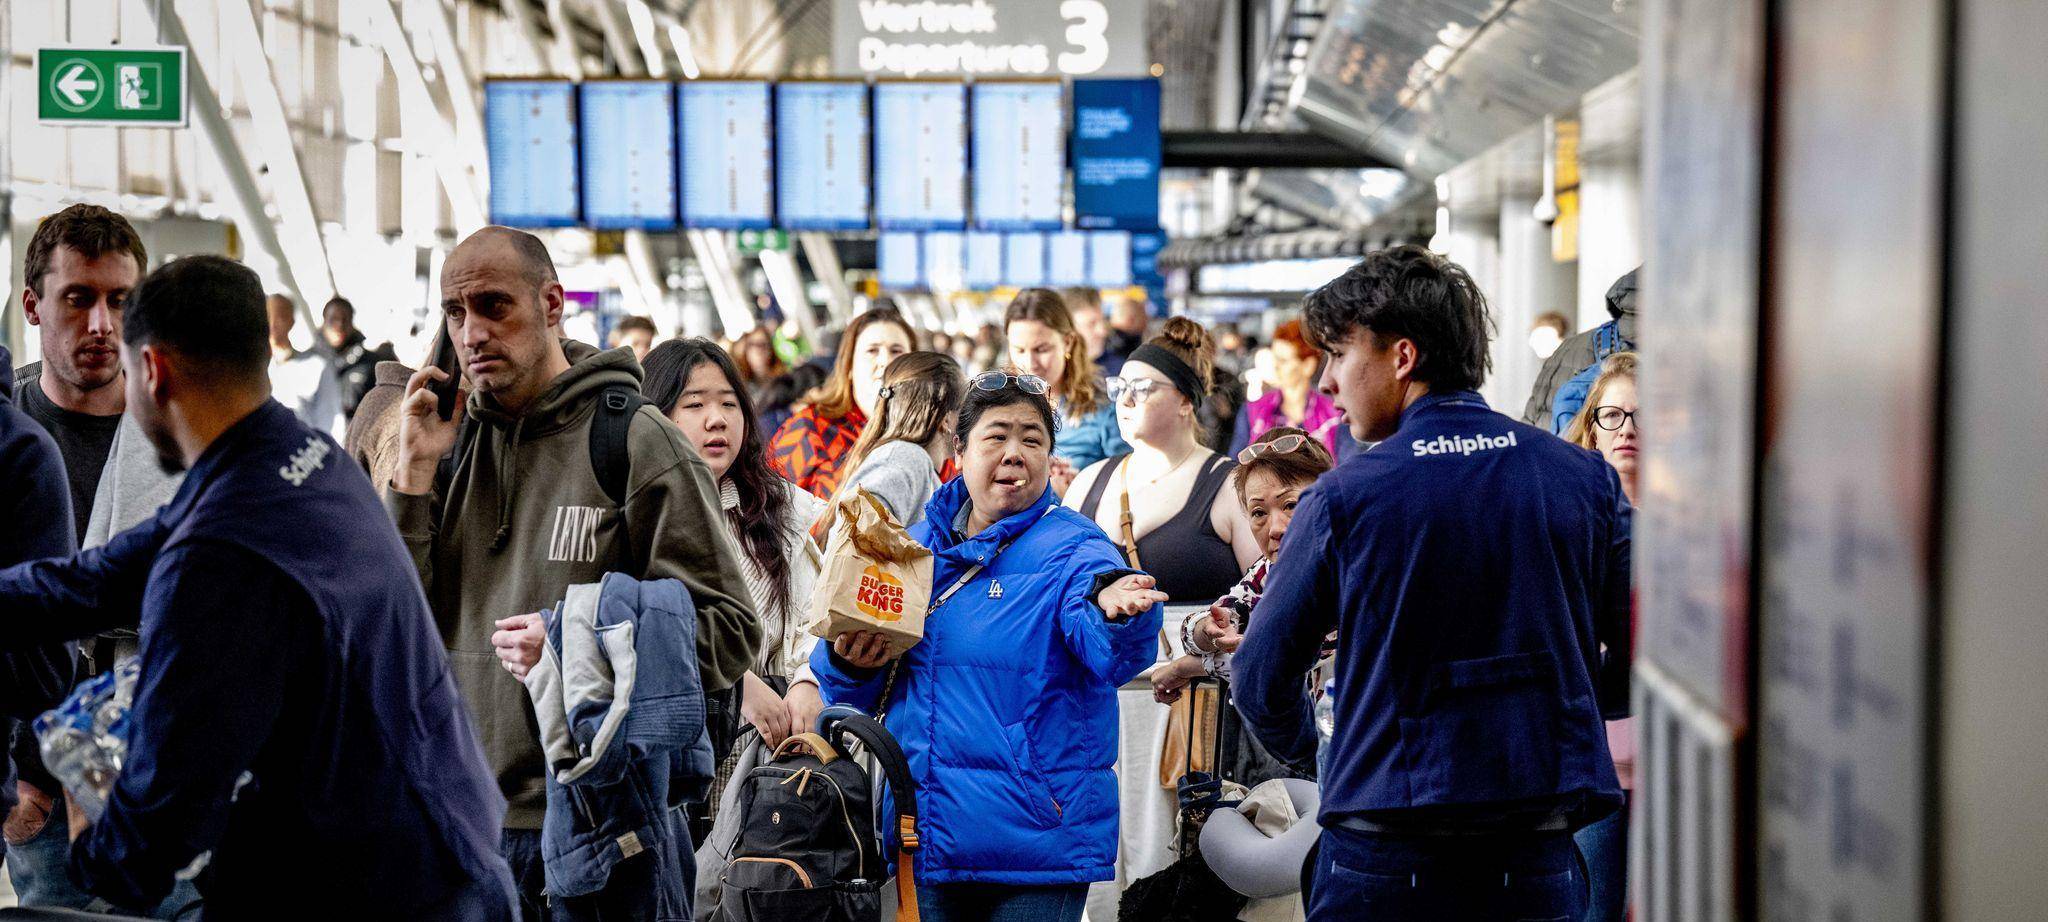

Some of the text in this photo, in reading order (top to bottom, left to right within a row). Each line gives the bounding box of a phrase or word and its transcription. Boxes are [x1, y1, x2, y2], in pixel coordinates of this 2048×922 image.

[1057, 0, 1109, 75] 3
[859, 37, 1049, 78] Departures
[1412, 431, 1517, 457] Schiphol
[857, 586, 904, 614] KING
[988, 579, 1003, 598] LA
